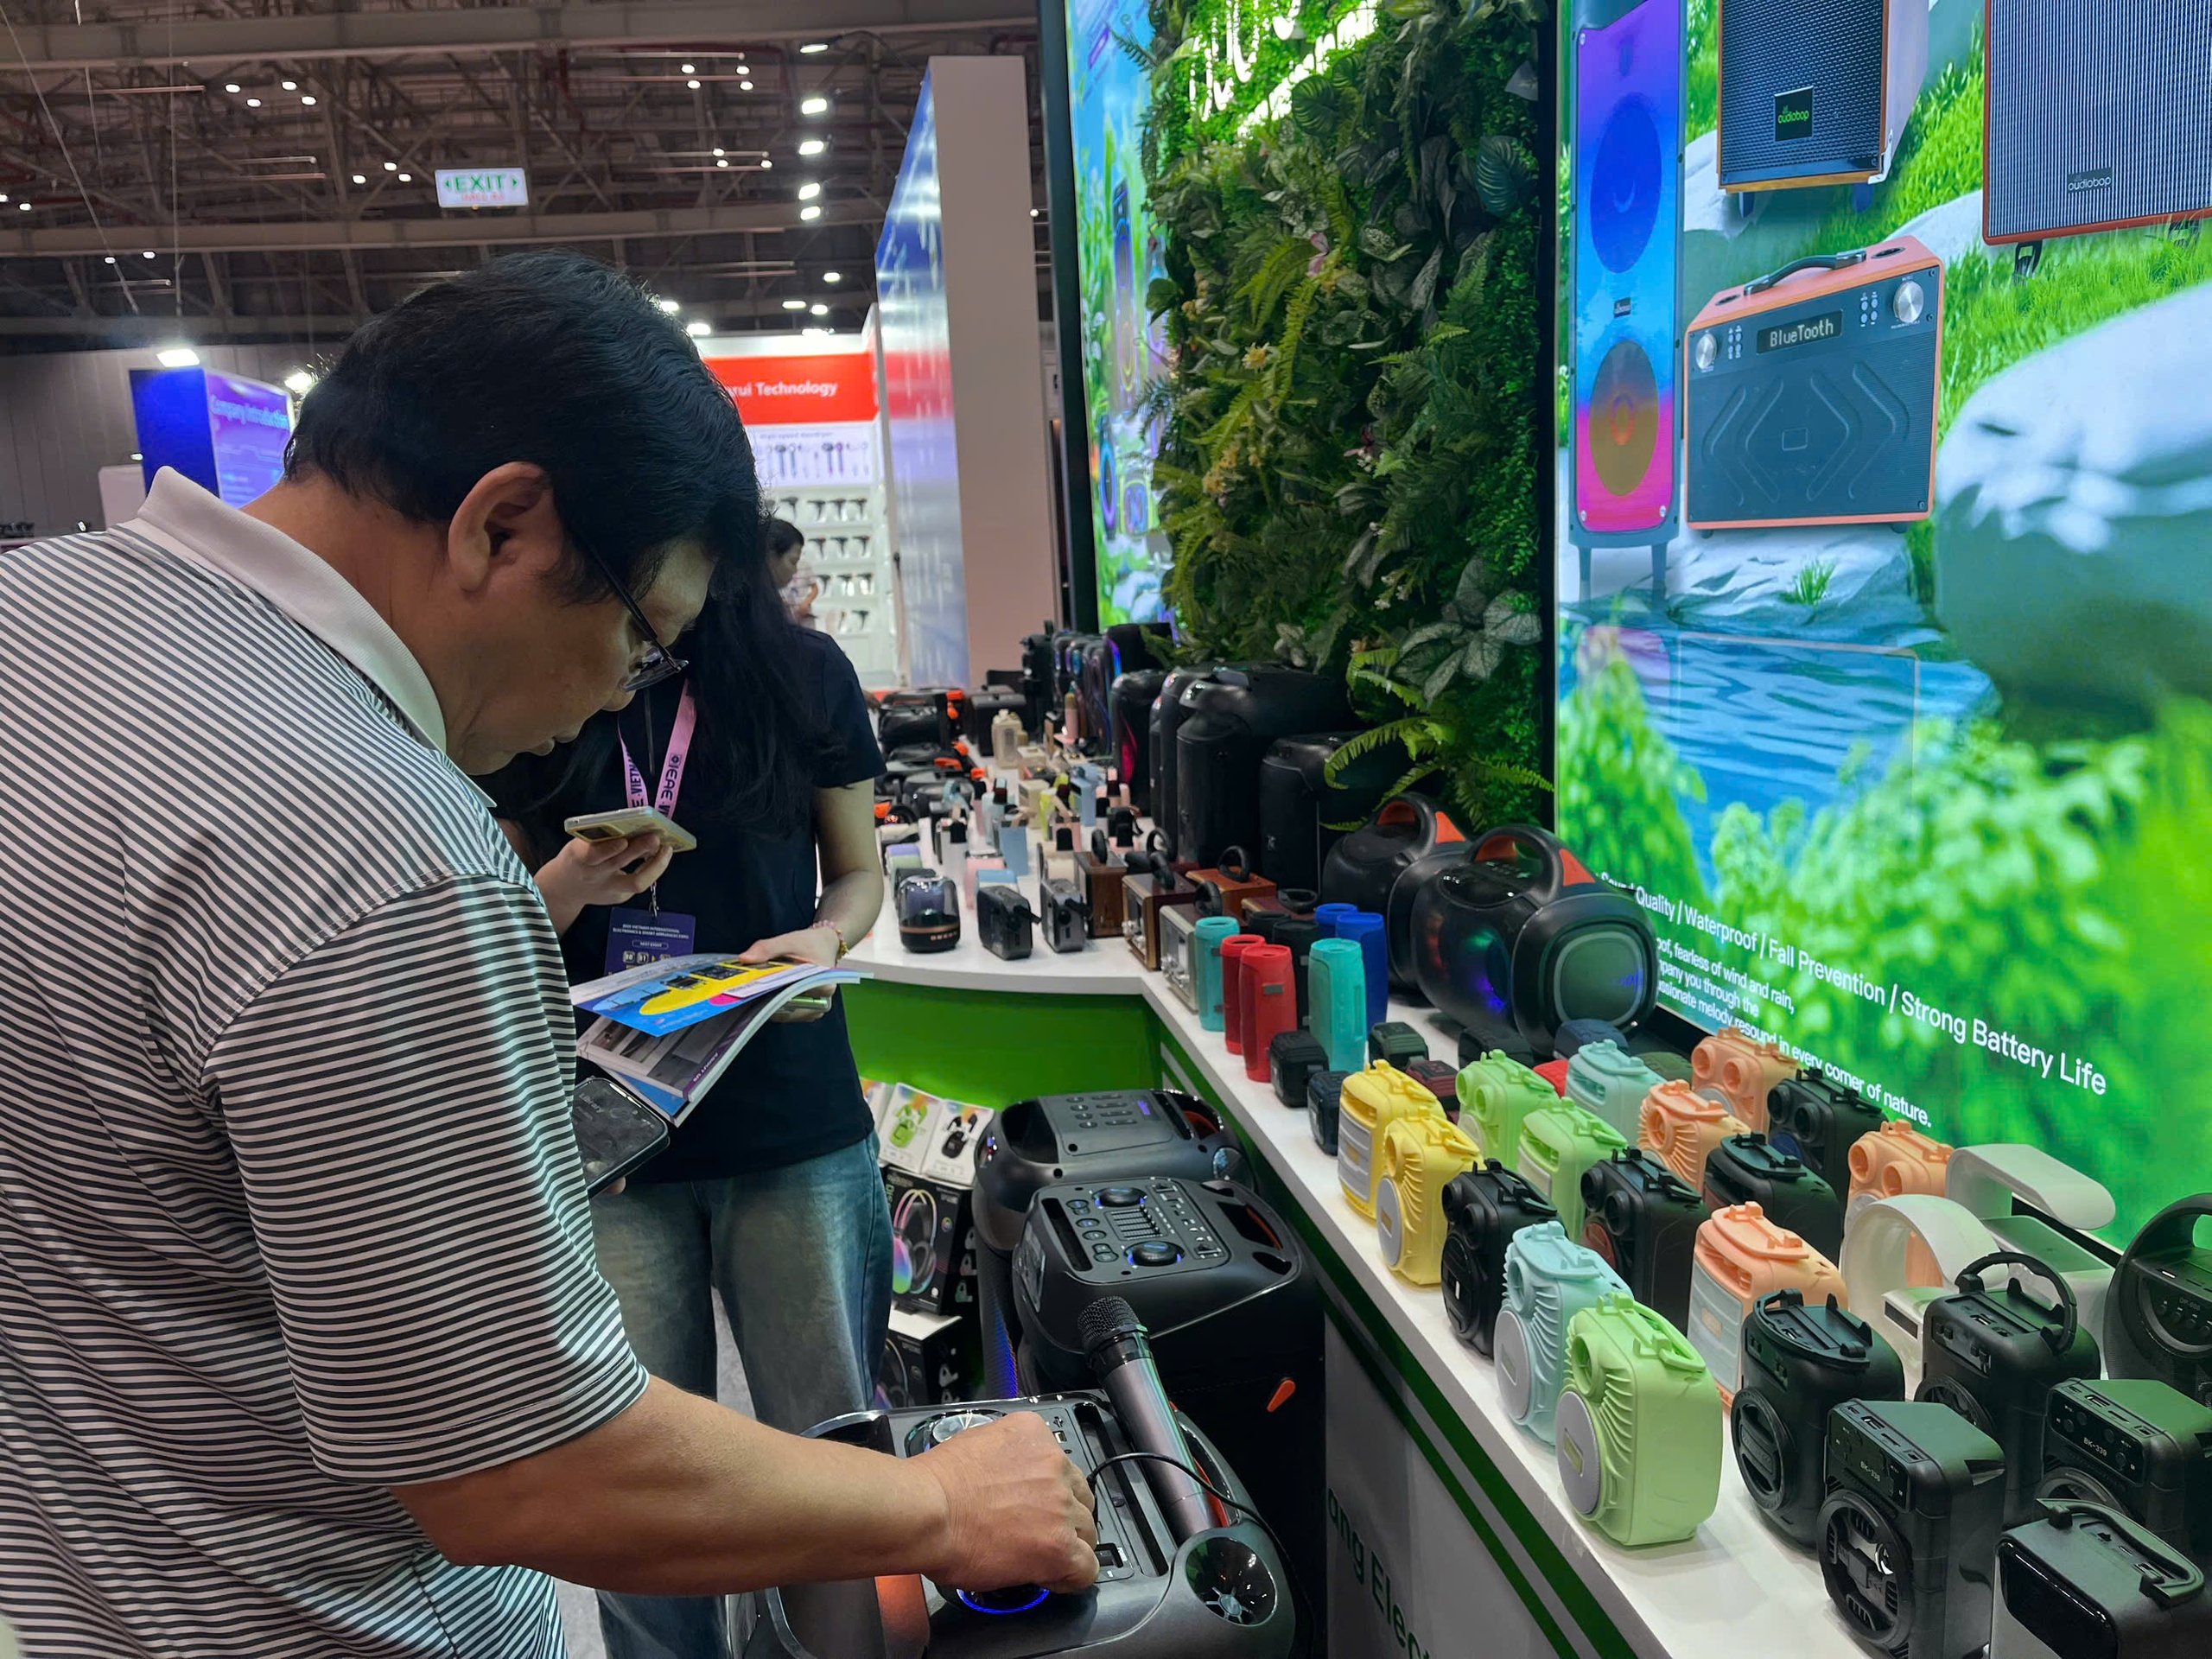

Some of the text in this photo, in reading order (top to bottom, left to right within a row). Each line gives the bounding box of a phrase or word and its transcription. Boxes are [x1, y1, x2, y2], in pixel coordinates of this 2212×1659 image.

[454, 175, 505, 191] EXIT
[1770, 318, 1834, 347] BlueTooth
[754, 380, 839, 397] Technology
[1636, 886, 1676, 923] Quality
[1685, 904, 1758, 951] Waterproof
[1769, 938, 1795, 969] Fall
[1798, 950, 1885, 1007] Prevention
[1901, 991, 1967, 1045] Strong
[1973, 1018, 2054, 1079] Battery
[2060, 1052, 2107, 1096] Life
[1674, 943, 1710, 972] fearless
[1711, 961, 1723, 977] of
[1723, 967, 1747, 989] wind
[1750, 979, 1769, 999] and
[1771, 989, 1795, 1014] rain,
[1686, 971, 1702, 989] you
[1704, 978, 1741, 1010] through
[1743, 996, 1759, 1018] the
[1698, 997, 1733, 1027] melody
[1778, 1034, 1790, 1056] in
[1791, 1046, 1824, 1070] every
[1825, 1062, 1866, 1093] corner
[1866, 1084, 1881, 1102] of
[1884, 1091, 1932, 1128] nature.
[578, 1092, 605, 1114] Library
[1328, 1488, 1430, 1659] ang Elec
